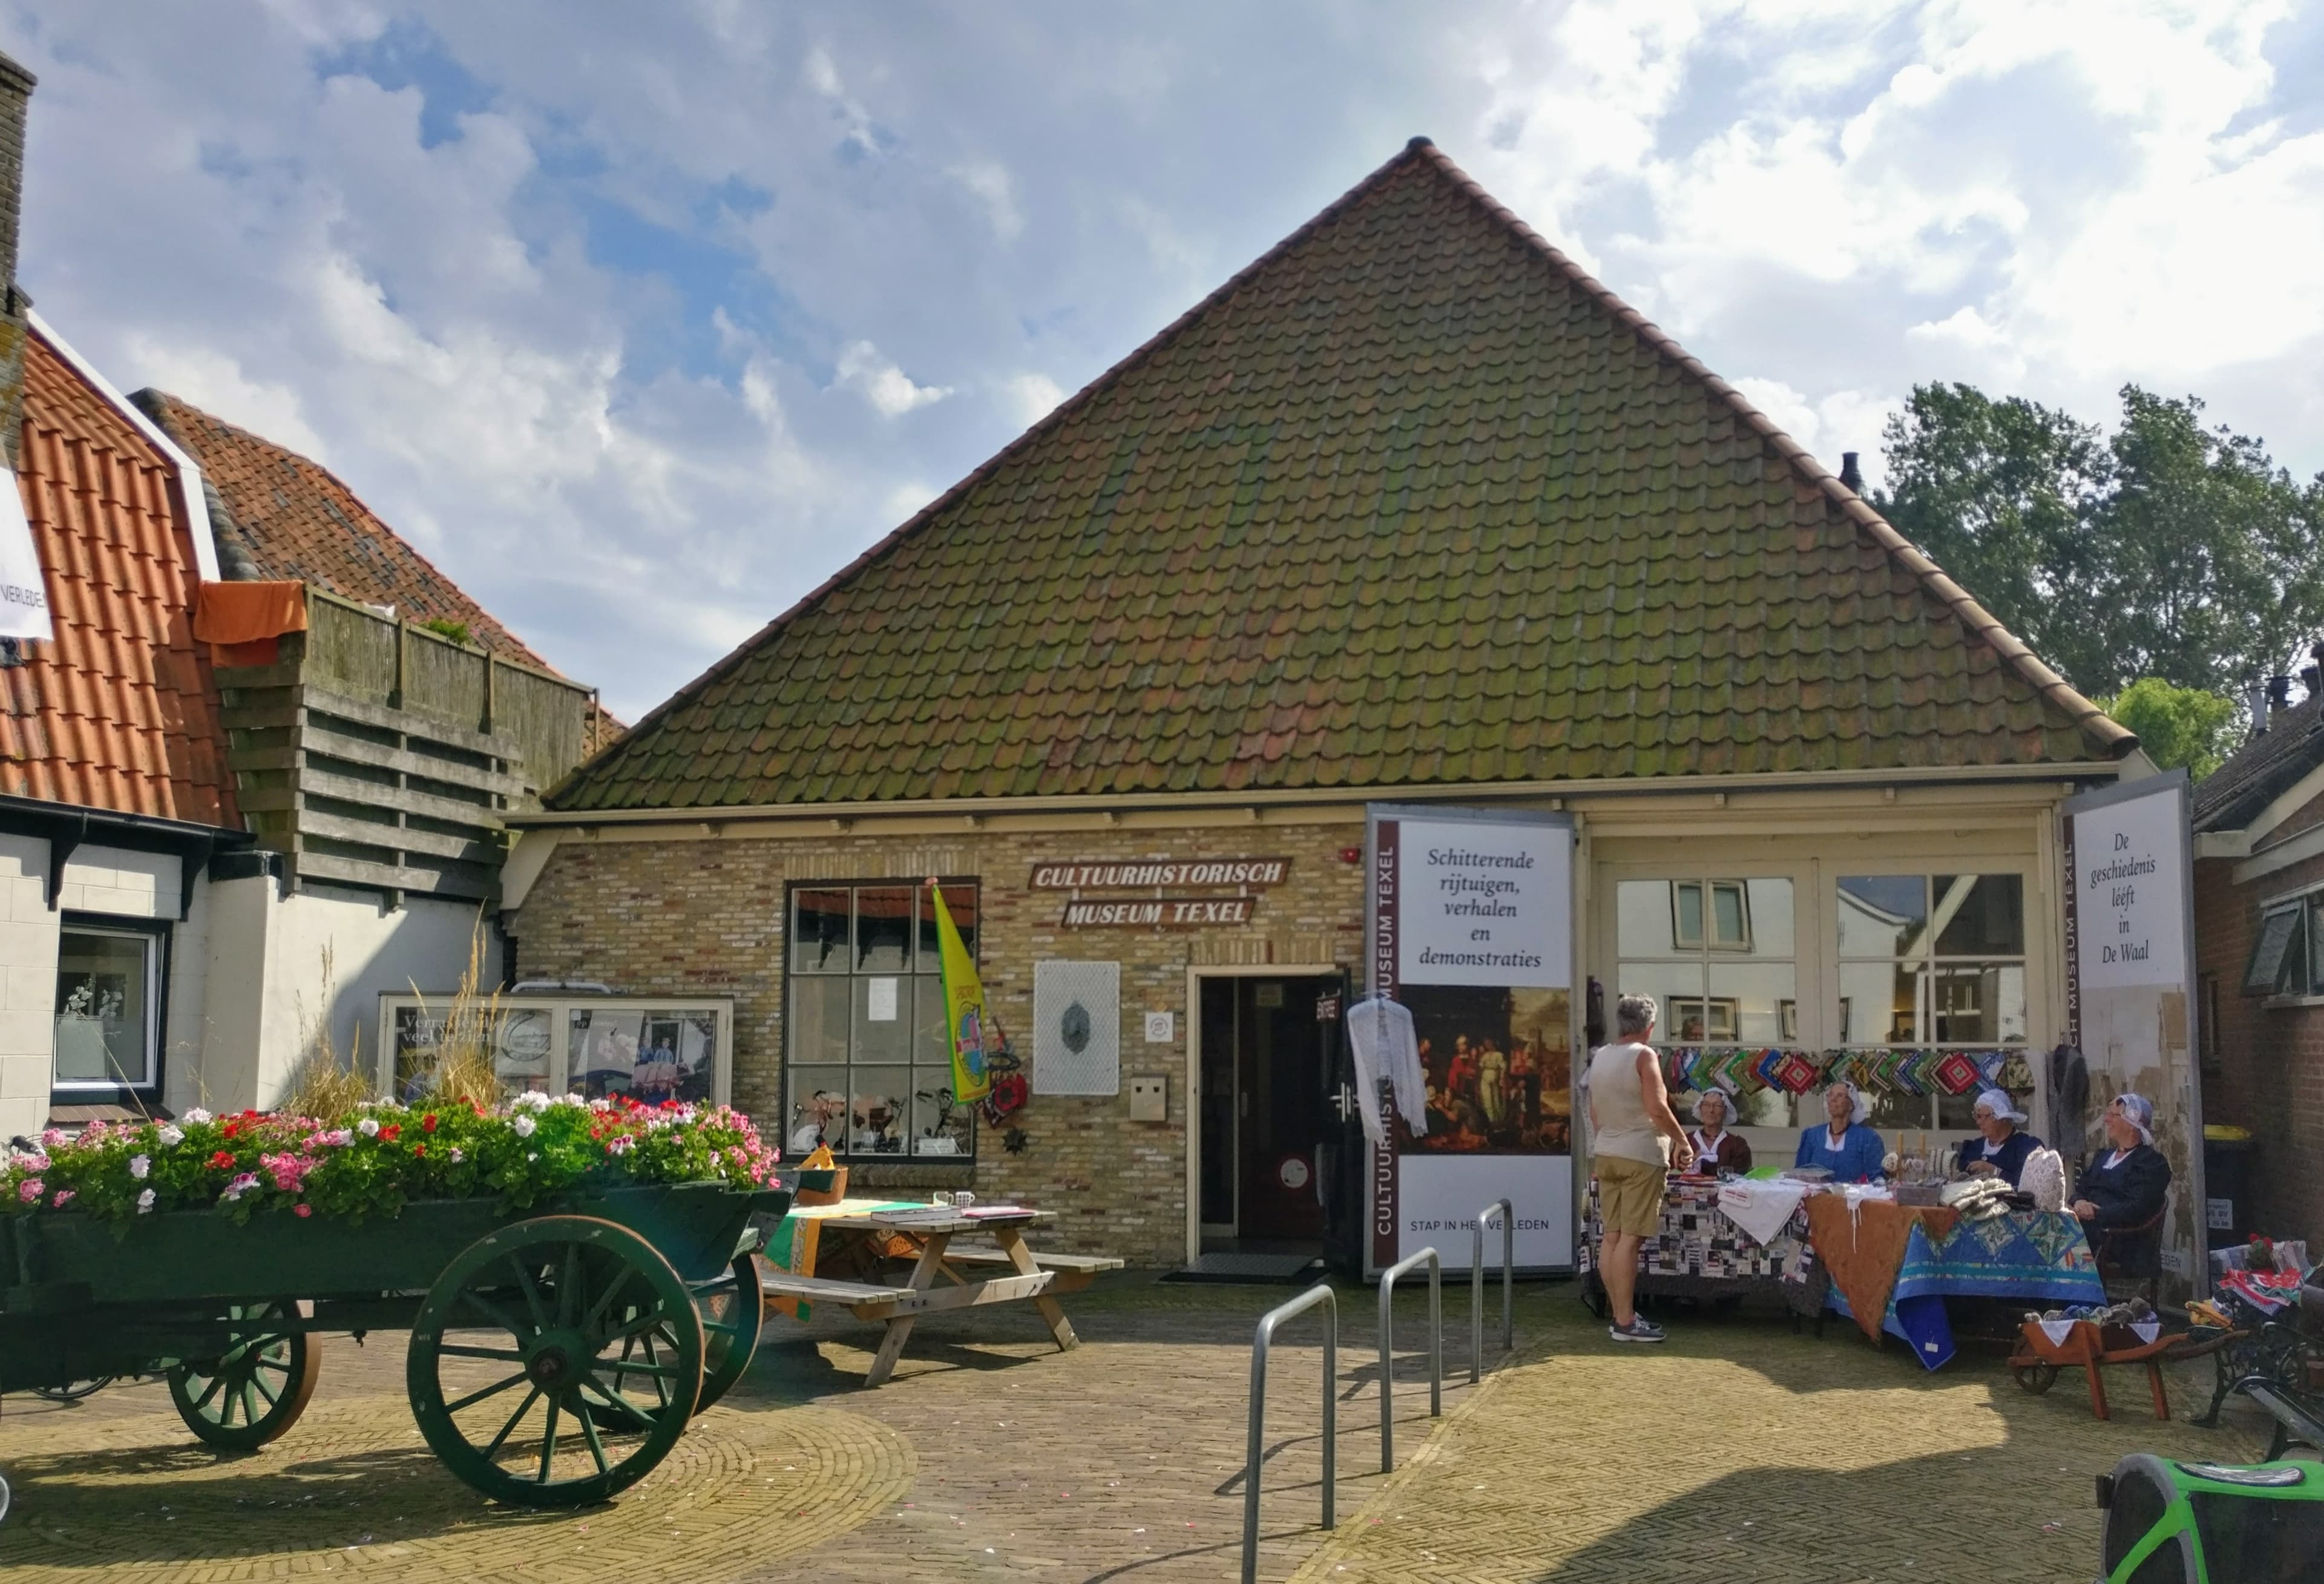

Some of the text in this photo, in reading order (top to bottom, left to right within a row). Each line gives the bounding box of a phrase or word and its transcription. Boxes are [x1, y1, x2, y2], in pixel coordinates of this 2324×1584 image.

[2114, 832, 2129, 851] De
[1427, 848, 1535, 869] Schitterende
[1036, 863, 1283, 887] CULTUURHISTORISCH
[1379, 846, 1393, 907] TEXEL
[2064, 844, 2073, 908] TEXEL
[2090, 853, 2156, 889] geschiedenis
[1440, 873, 1520, 897] rijtuigen,
[1445, 898, 1517, 917] verhalen
[2112, 885, 2135, 912] lééft
[1065, 902, 1247, 924] MUSEUM TEXEL
[2119, 915, 2130, 934] in
[1470, 928, 1490, 941] en
[1419, 945, 1542, 967] demonstraties
[2102, 939, 2148, 964] De Waal
[2066, 917, 2076, 1010] MUSEUM
[1410, 1220, 1549, 1231] STAP IN HE VEEDEN
